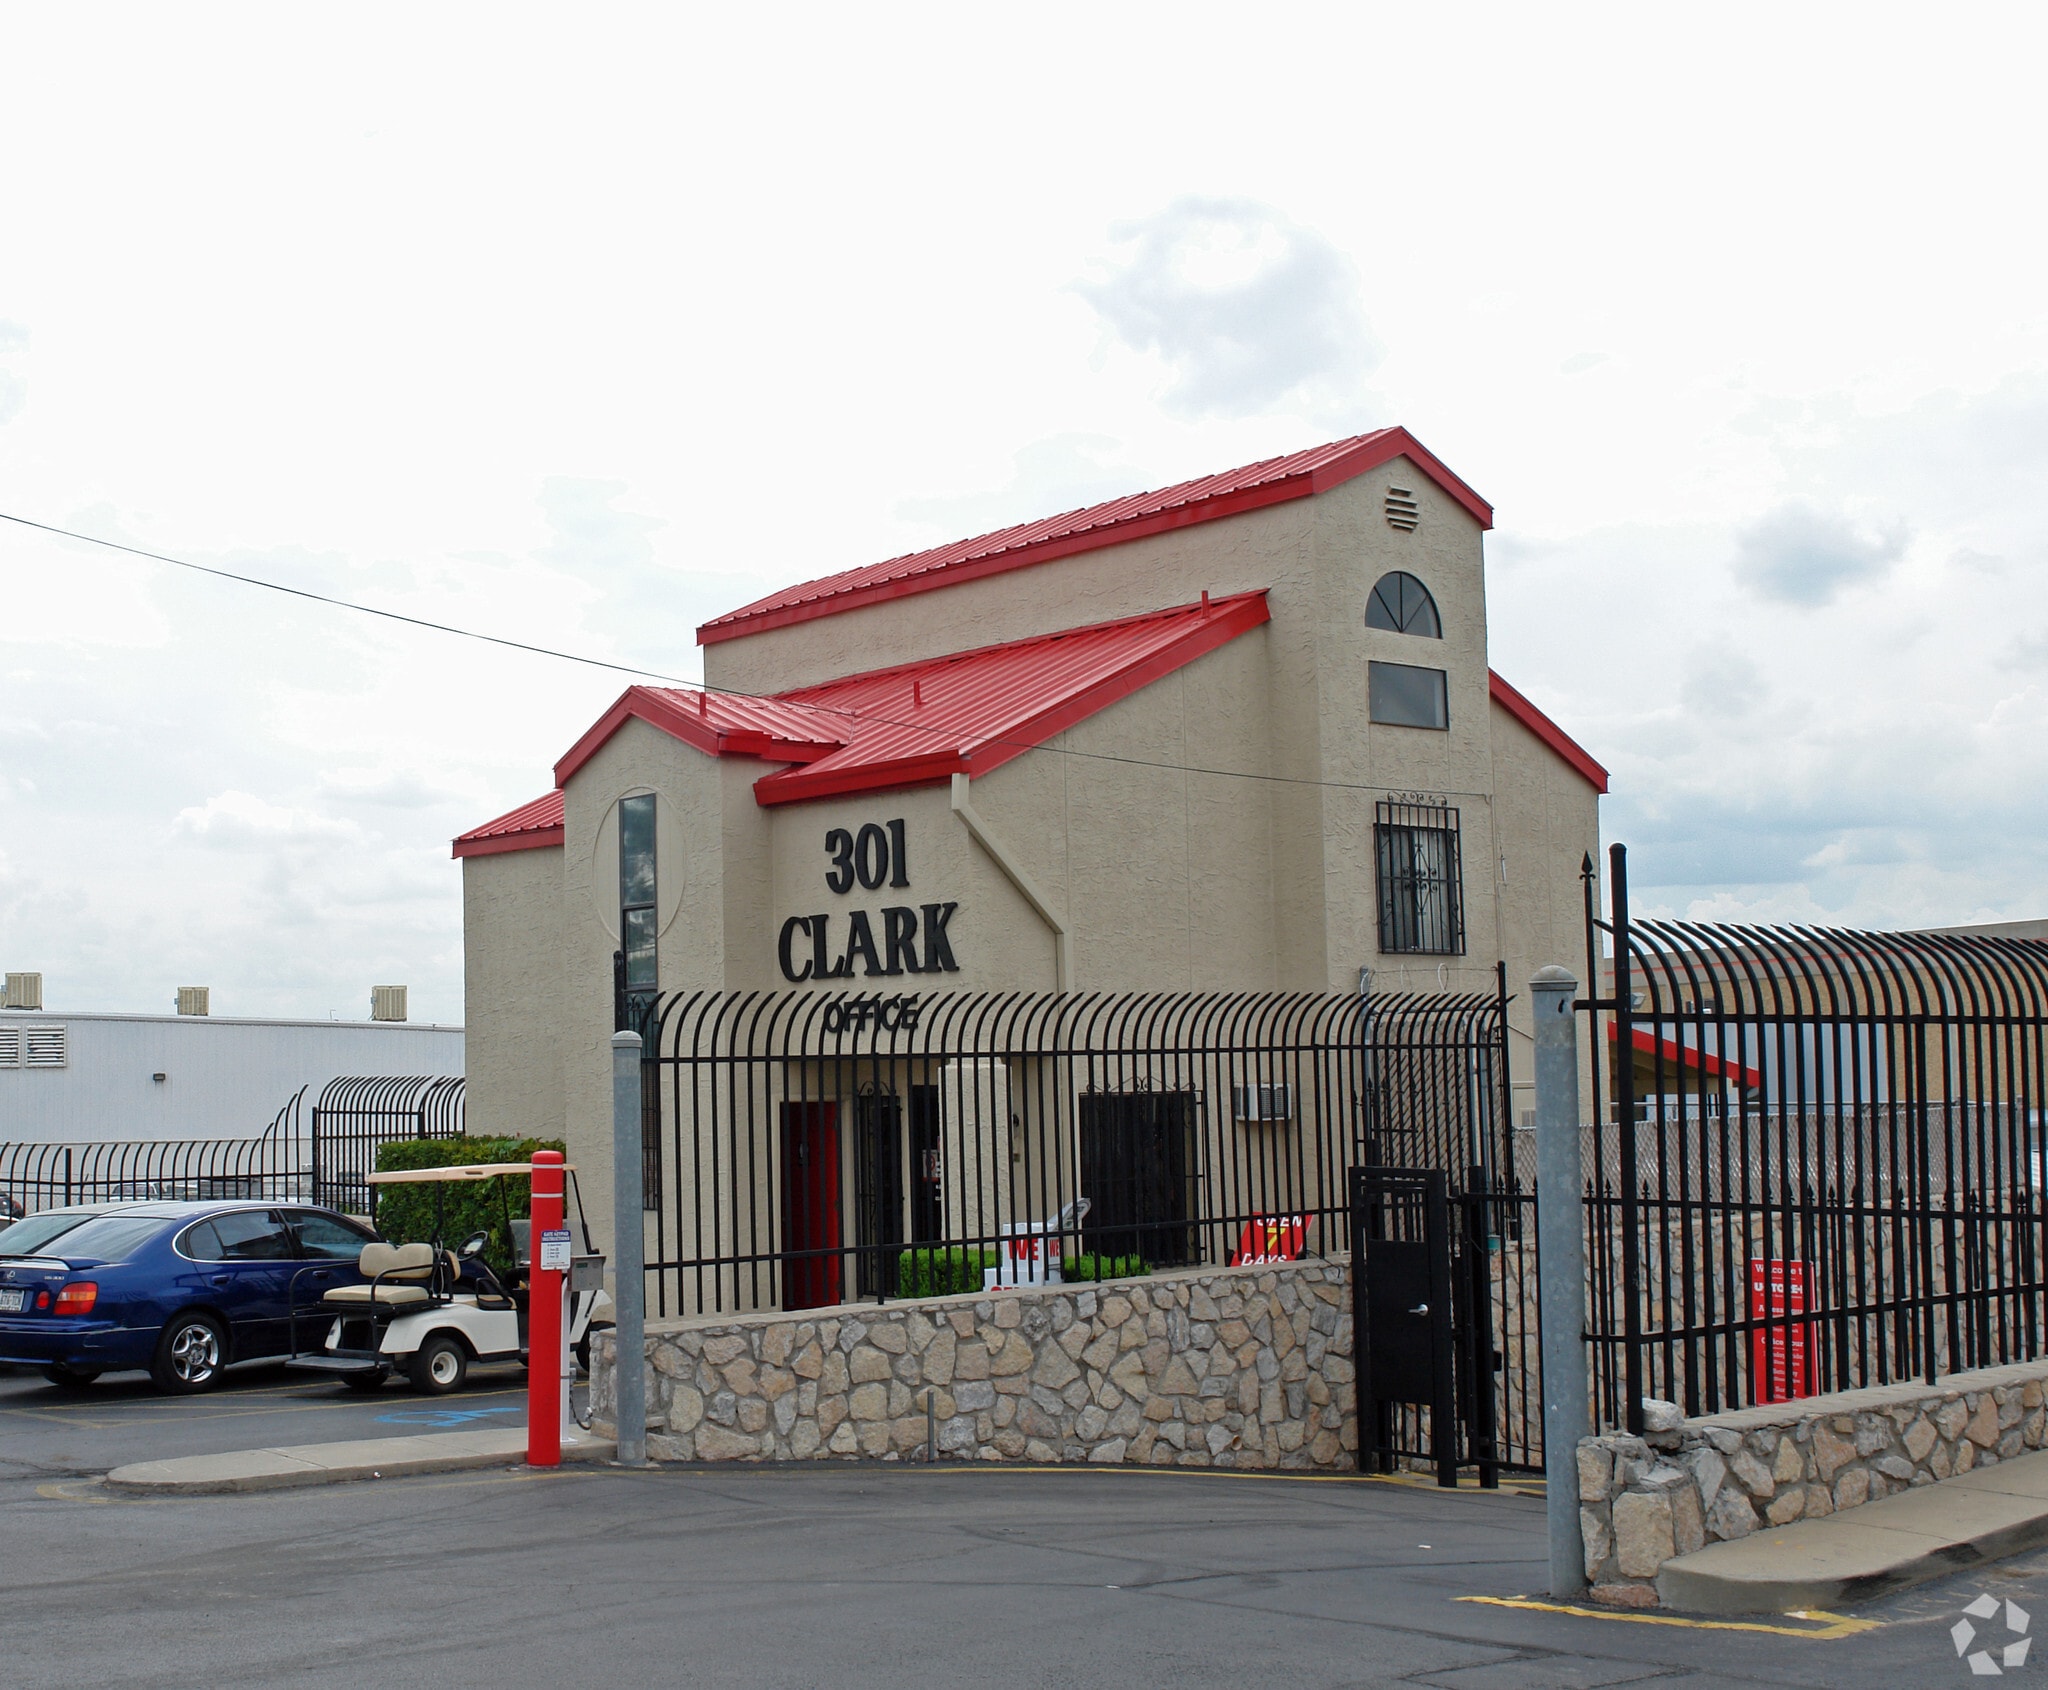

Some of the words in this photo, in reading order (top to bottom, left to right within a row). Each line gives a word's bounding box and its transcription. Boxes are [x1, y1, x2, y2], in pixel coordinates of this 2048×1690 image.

[825, 818, 910, 894] 301
[778, 902, 960, 983] CLARK
[823, 998, 918, 1033] OFFICE
[1262, 1227, 1286, 1254] 7
[1240, 1252, 1288, 1266] DAYS
[1755, 1264, 1796, 1275] Wcoe
